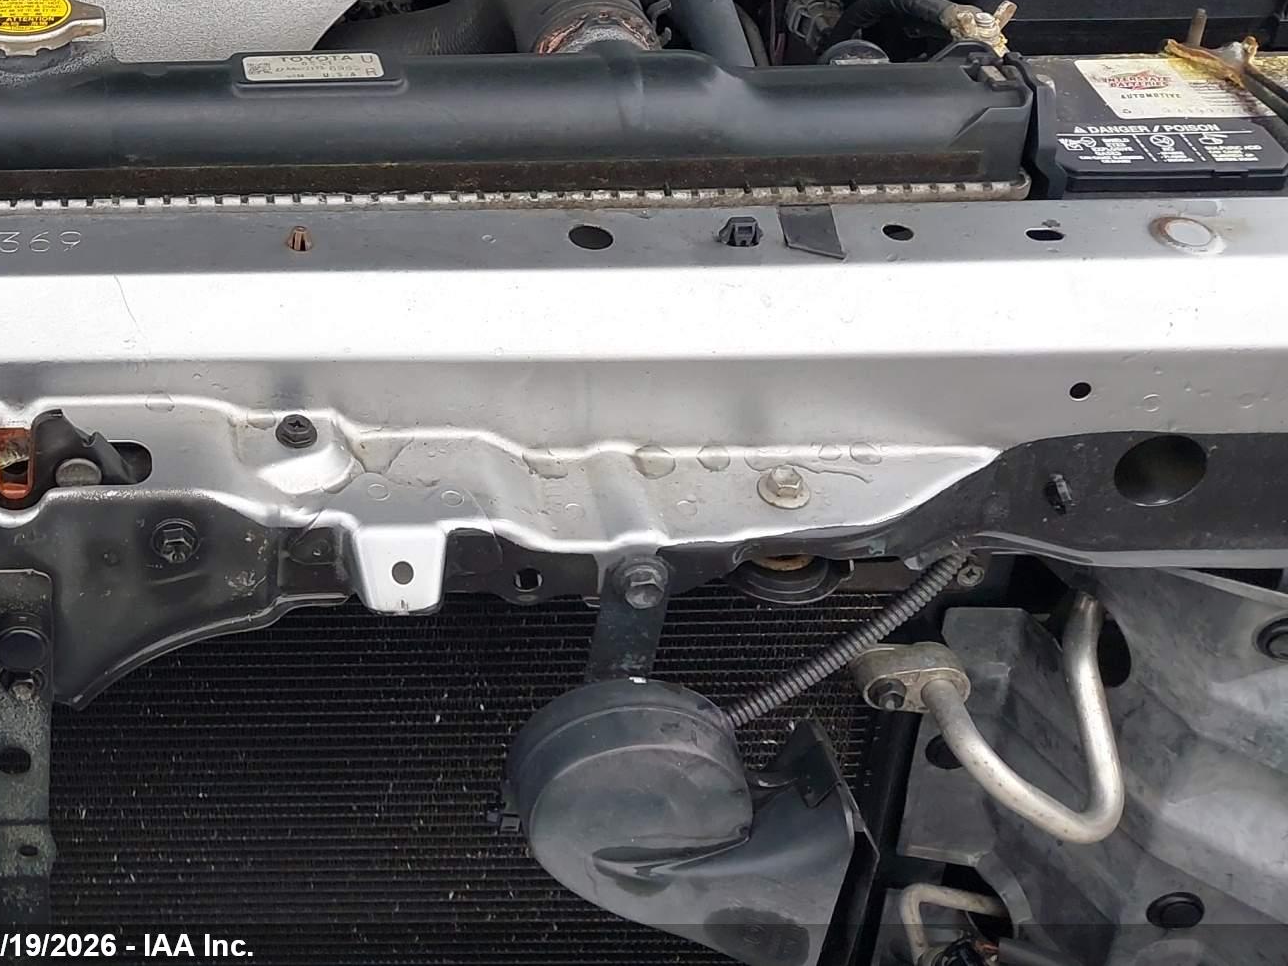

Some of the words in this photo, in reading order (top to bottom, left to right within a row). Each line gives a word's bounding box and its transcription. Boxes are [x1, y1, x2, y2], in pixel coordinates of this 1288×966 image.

[1087, 125, 1150, 134] DANGER
[1152, 125, 1160, 133] /
[1163, 124, 1221, 132] POISON
